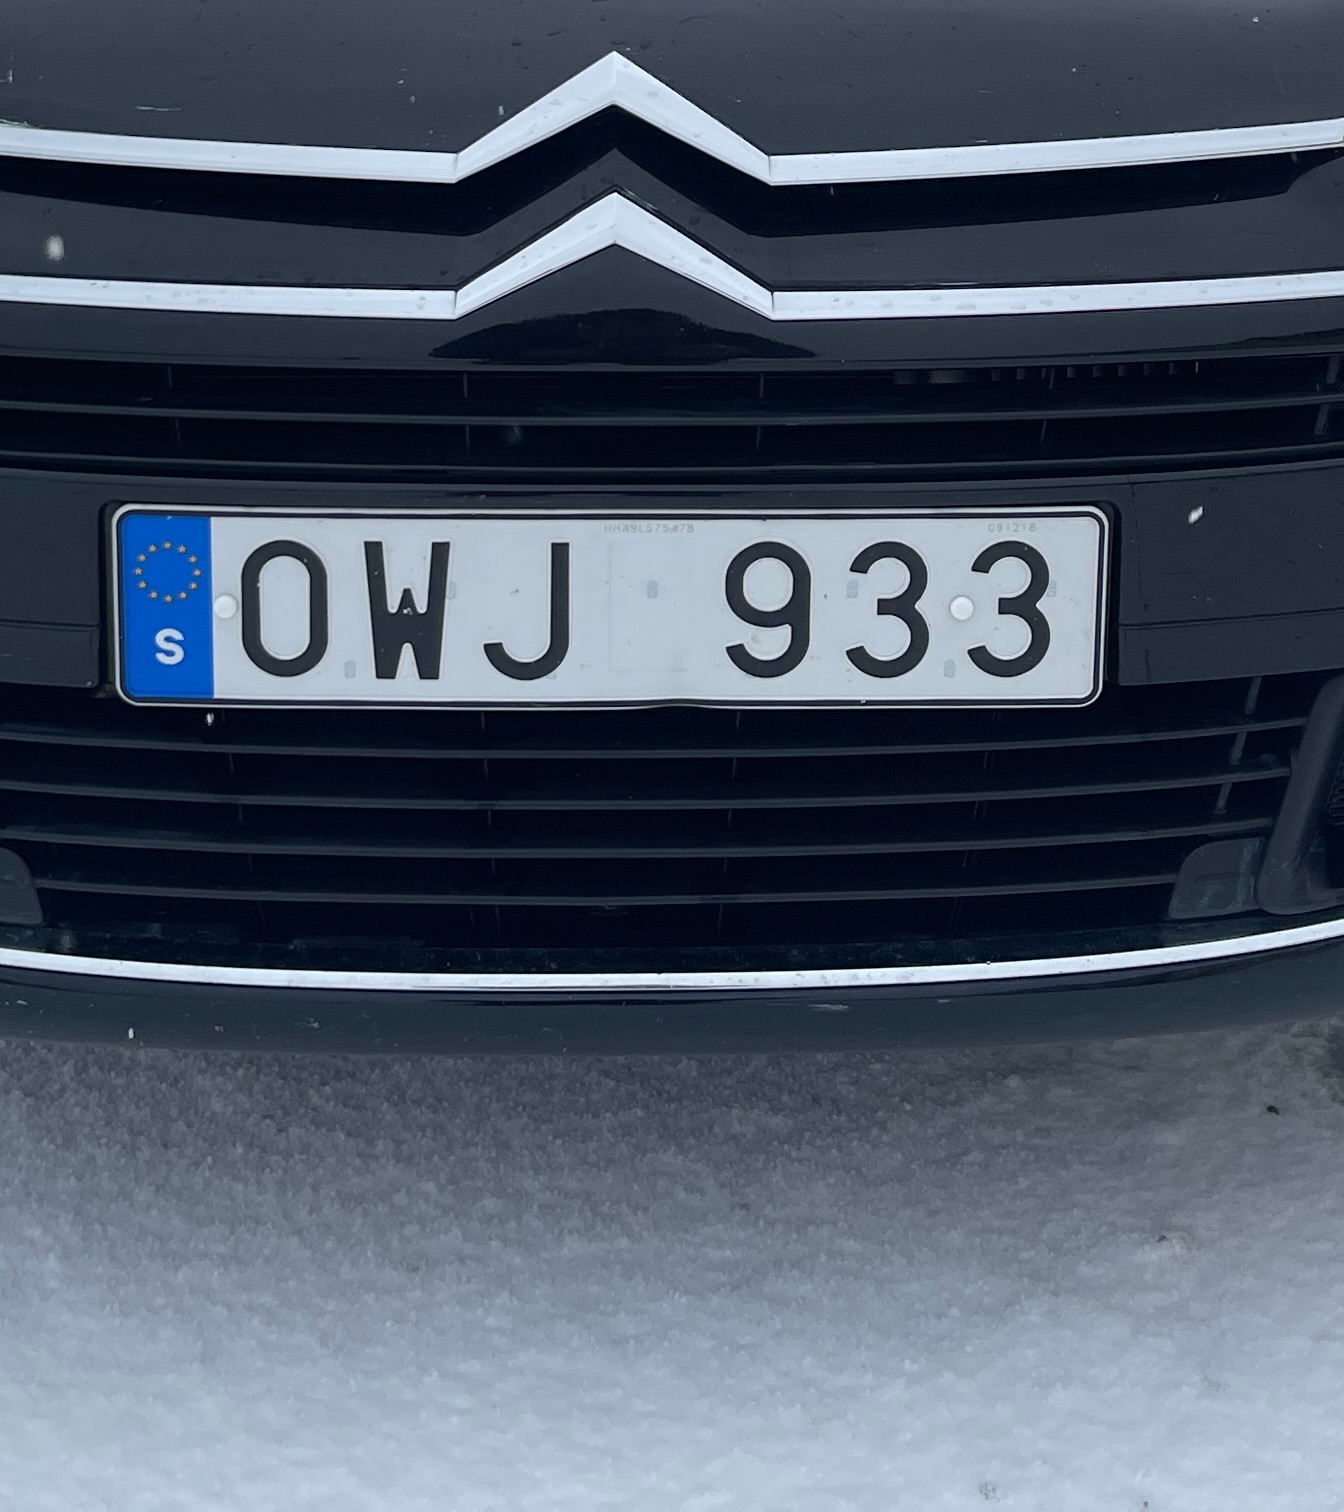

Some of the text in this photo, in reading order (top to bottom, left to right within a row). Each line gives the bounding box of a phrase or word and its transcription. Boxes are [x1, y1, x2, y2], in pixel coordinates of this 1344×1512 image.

[155, 628, 185, 665] S
[241, 539, 1051, 681] OWJ 933
